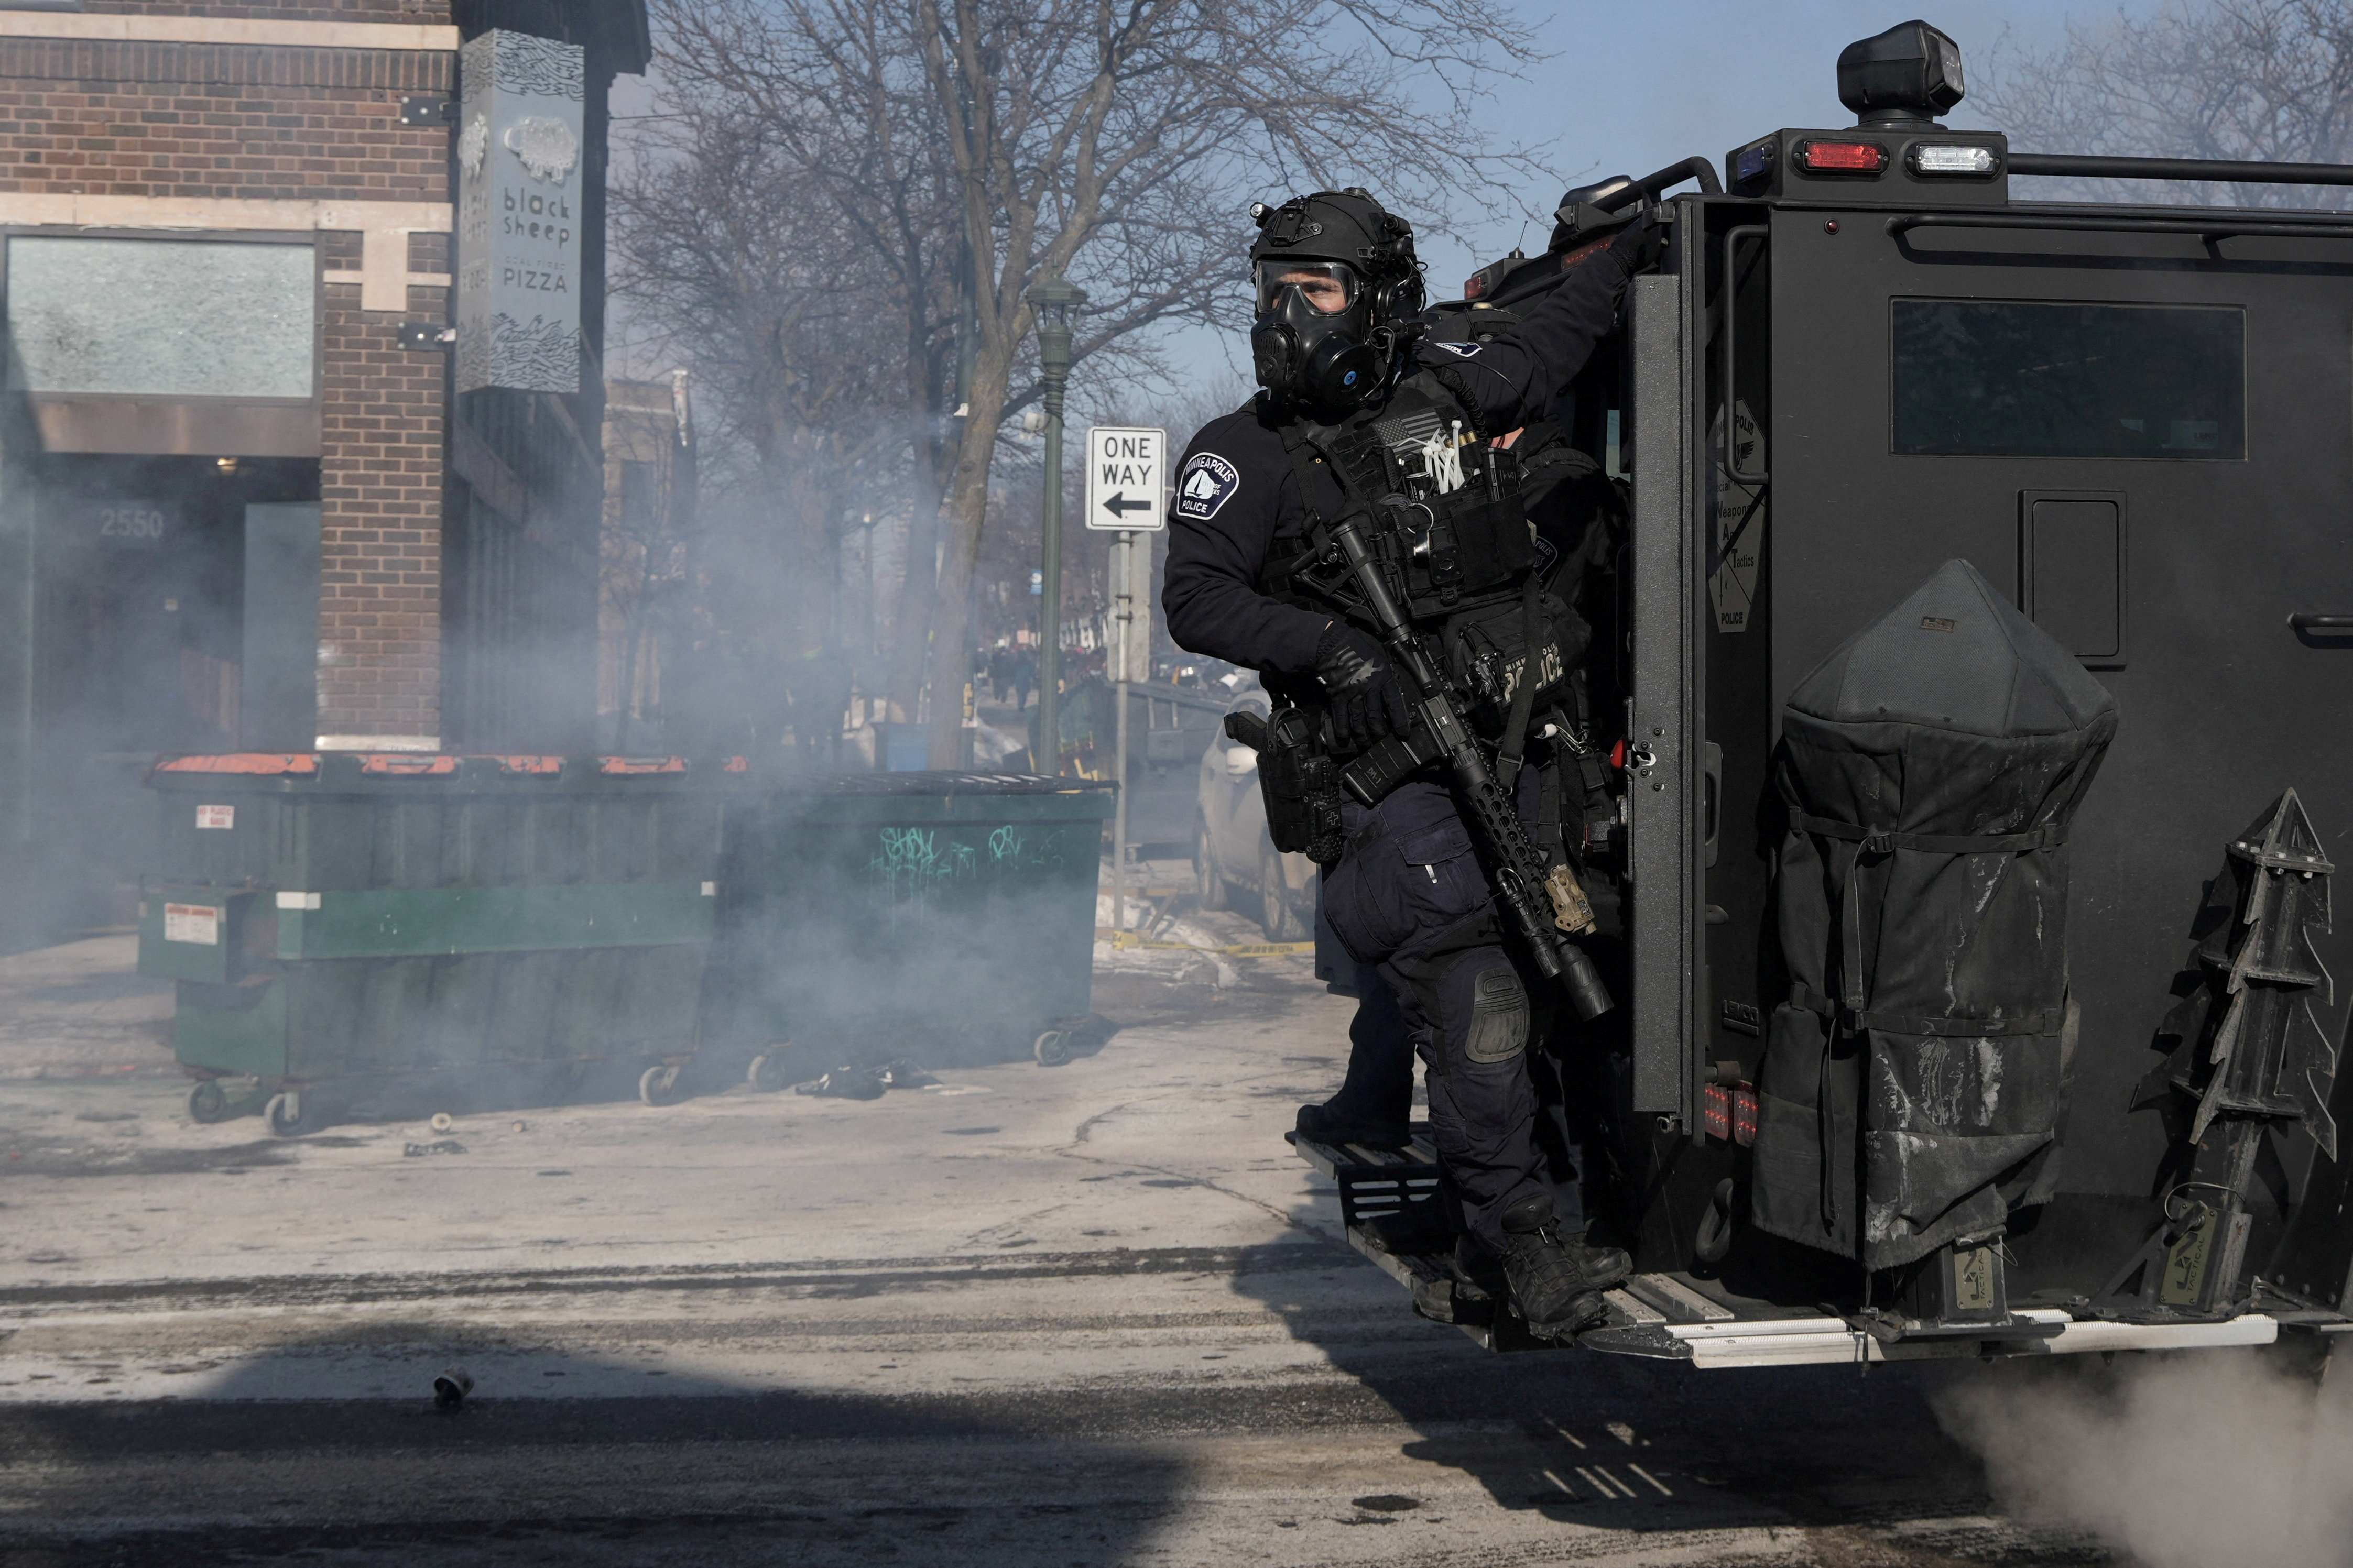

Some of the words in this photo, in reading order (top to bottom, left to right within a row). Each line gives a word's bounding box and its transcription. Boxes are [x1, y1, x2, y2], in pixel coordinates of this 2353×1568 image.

[504, 187, 569, 219] black
[504, 268, 568, 293] PIZZA
[1105, 437, 1151, 458] ONE
[1102, 464, 1152, 486] WAY
[1185, 457, 1234, 483] MINNEAPOLIS
[1181, 500, 1208, 513] POLICE
[101, 508, 164, 538] 2550
[1731, 549, 1754, 568] Tactics
[1721, 612, 1744, 624] POLICE
[2187, 1237, 2205, 1292] TACTICAL
